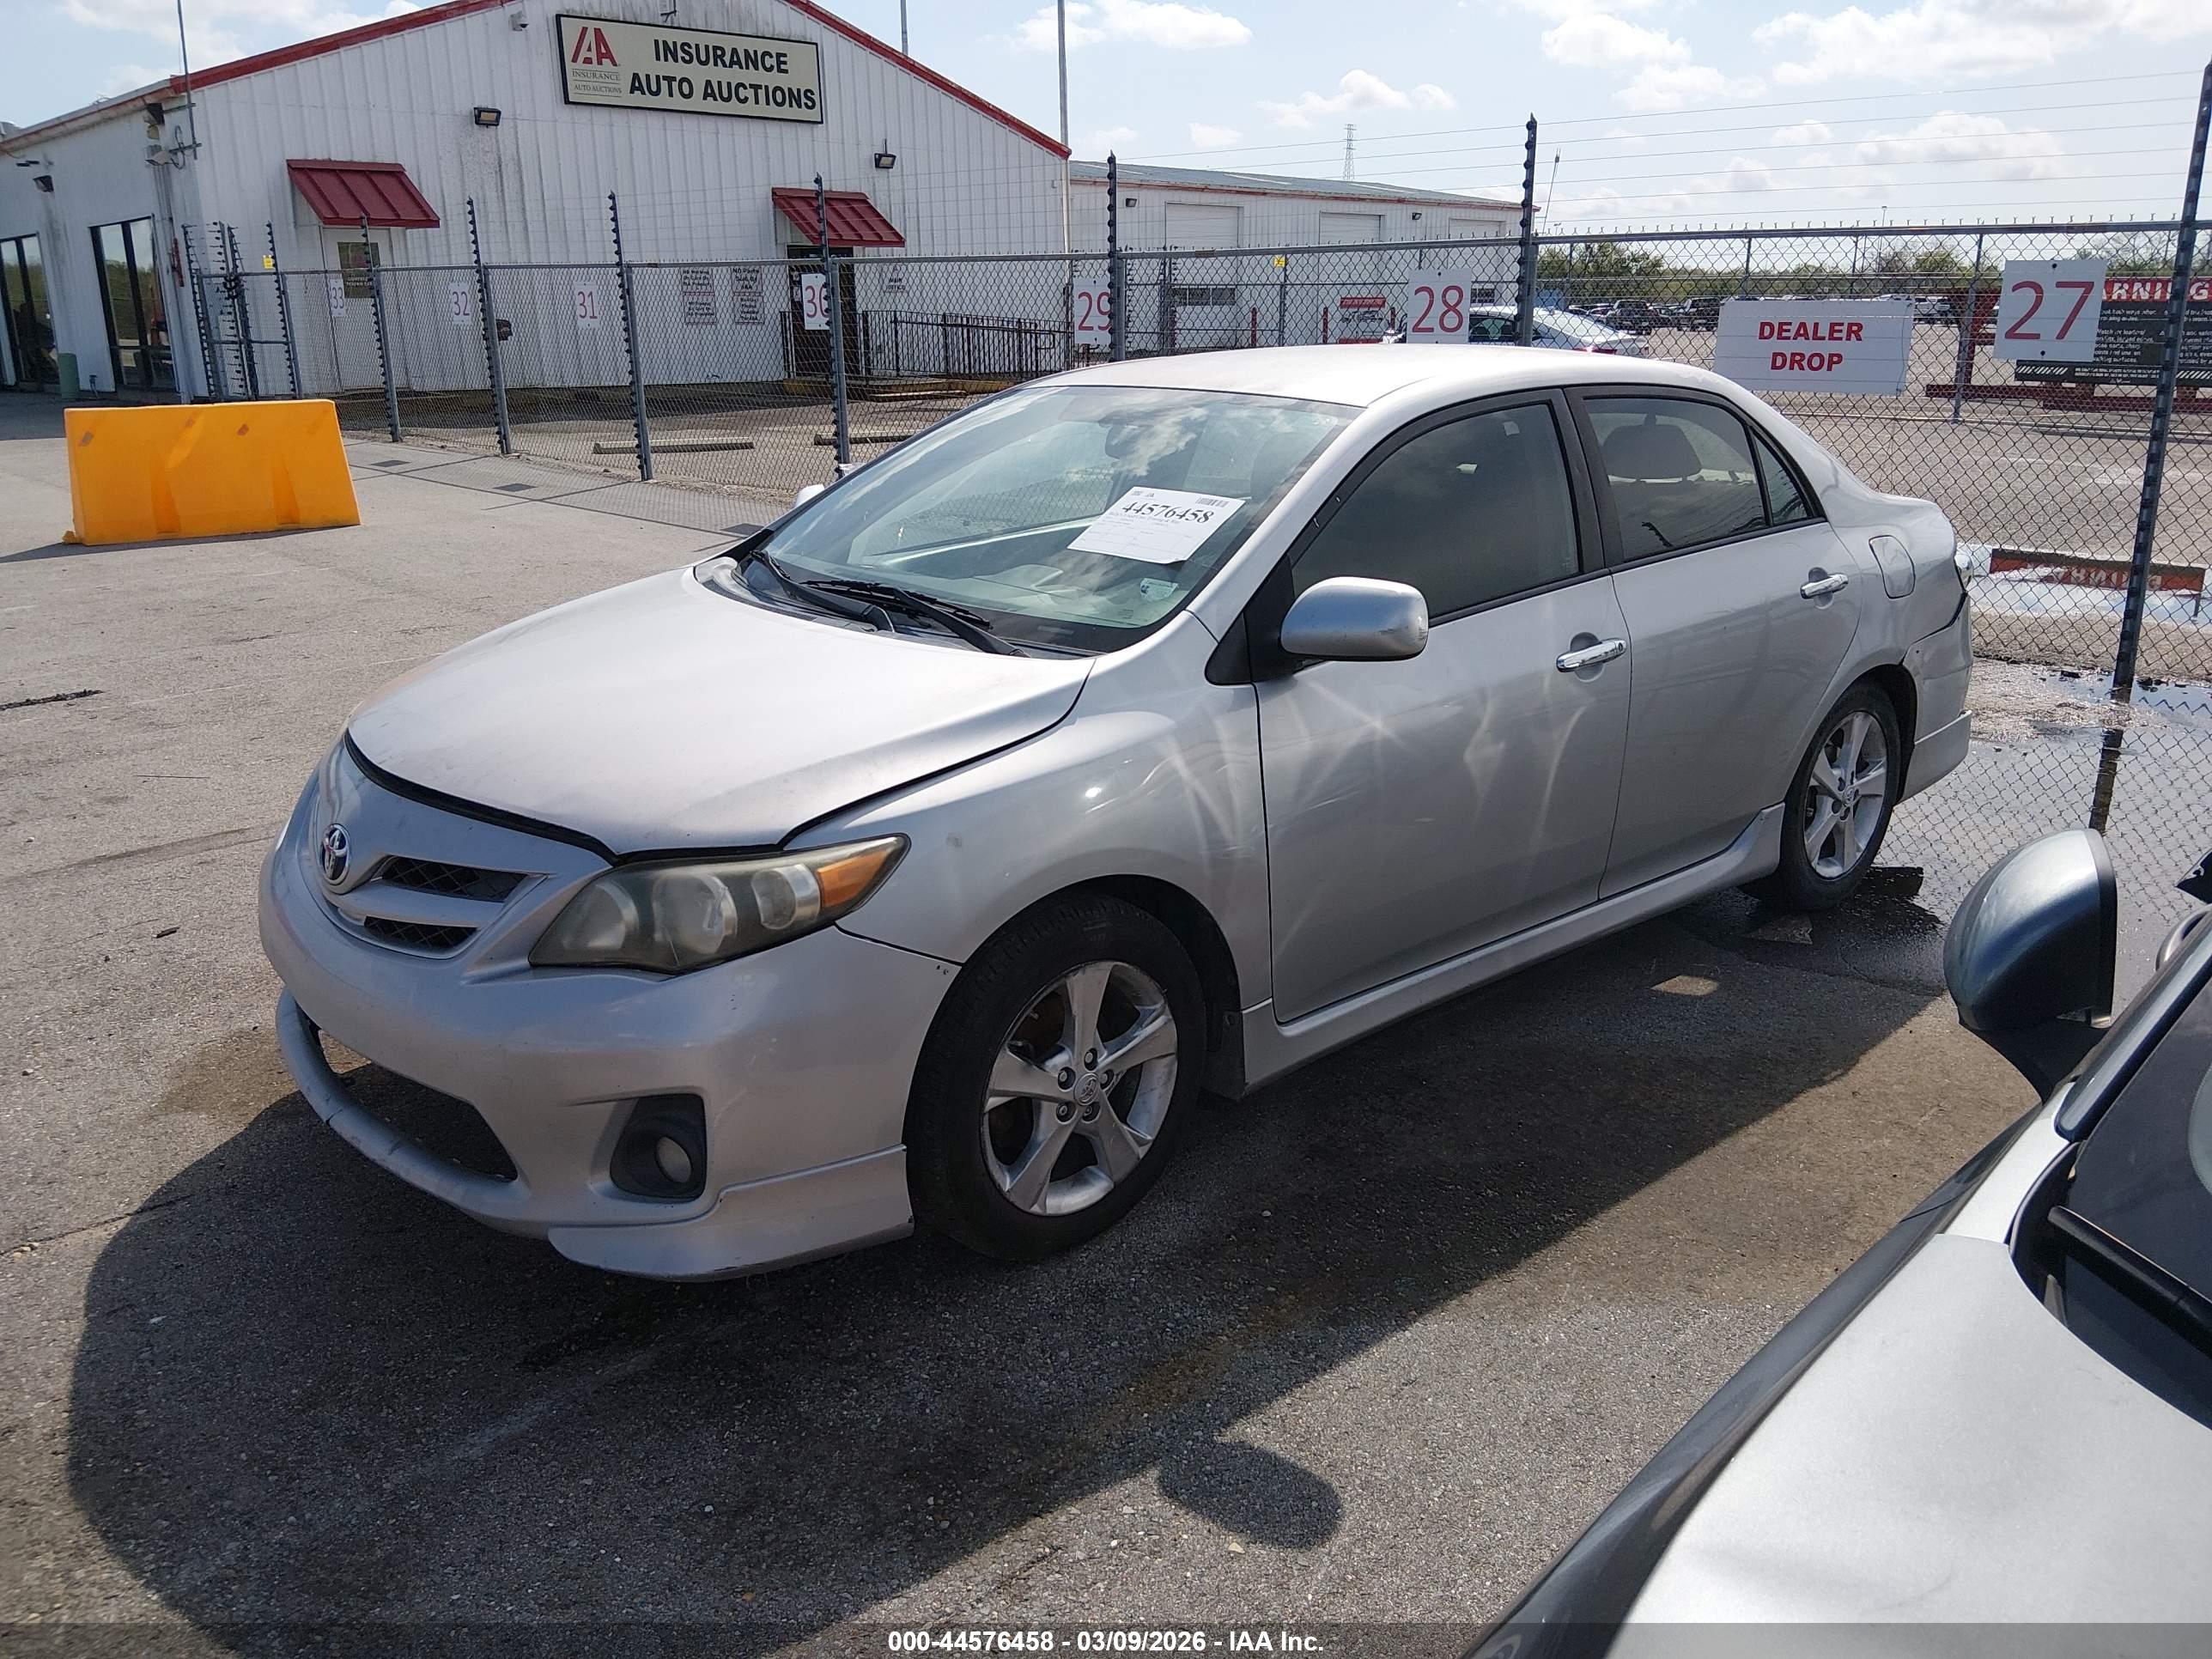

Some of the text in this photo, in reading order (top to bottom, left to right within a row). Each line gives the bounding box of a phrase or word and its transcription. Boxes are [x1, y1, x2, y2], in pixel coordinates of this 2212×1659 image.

[653, 39, 789, 75] INSURANCE
[572, 70, 621, 82] INSURANCE
[629, 72, 817, 110] AUTO AUCTIONS
[332, 286, 344, 309] 33
[452, 291, 471, 316] 32
[577, 290, 599, 319] 31
[1078, 291, 1113, 331] 29
[1412, 285, 1464, 333] 28
[2005, 281, 2095, 340] 27
[1758, 321, 1863, 342] DEALER
[1771, 351, 1843, 372] DROP
[1121, 501, 1214, 524] 44576458
